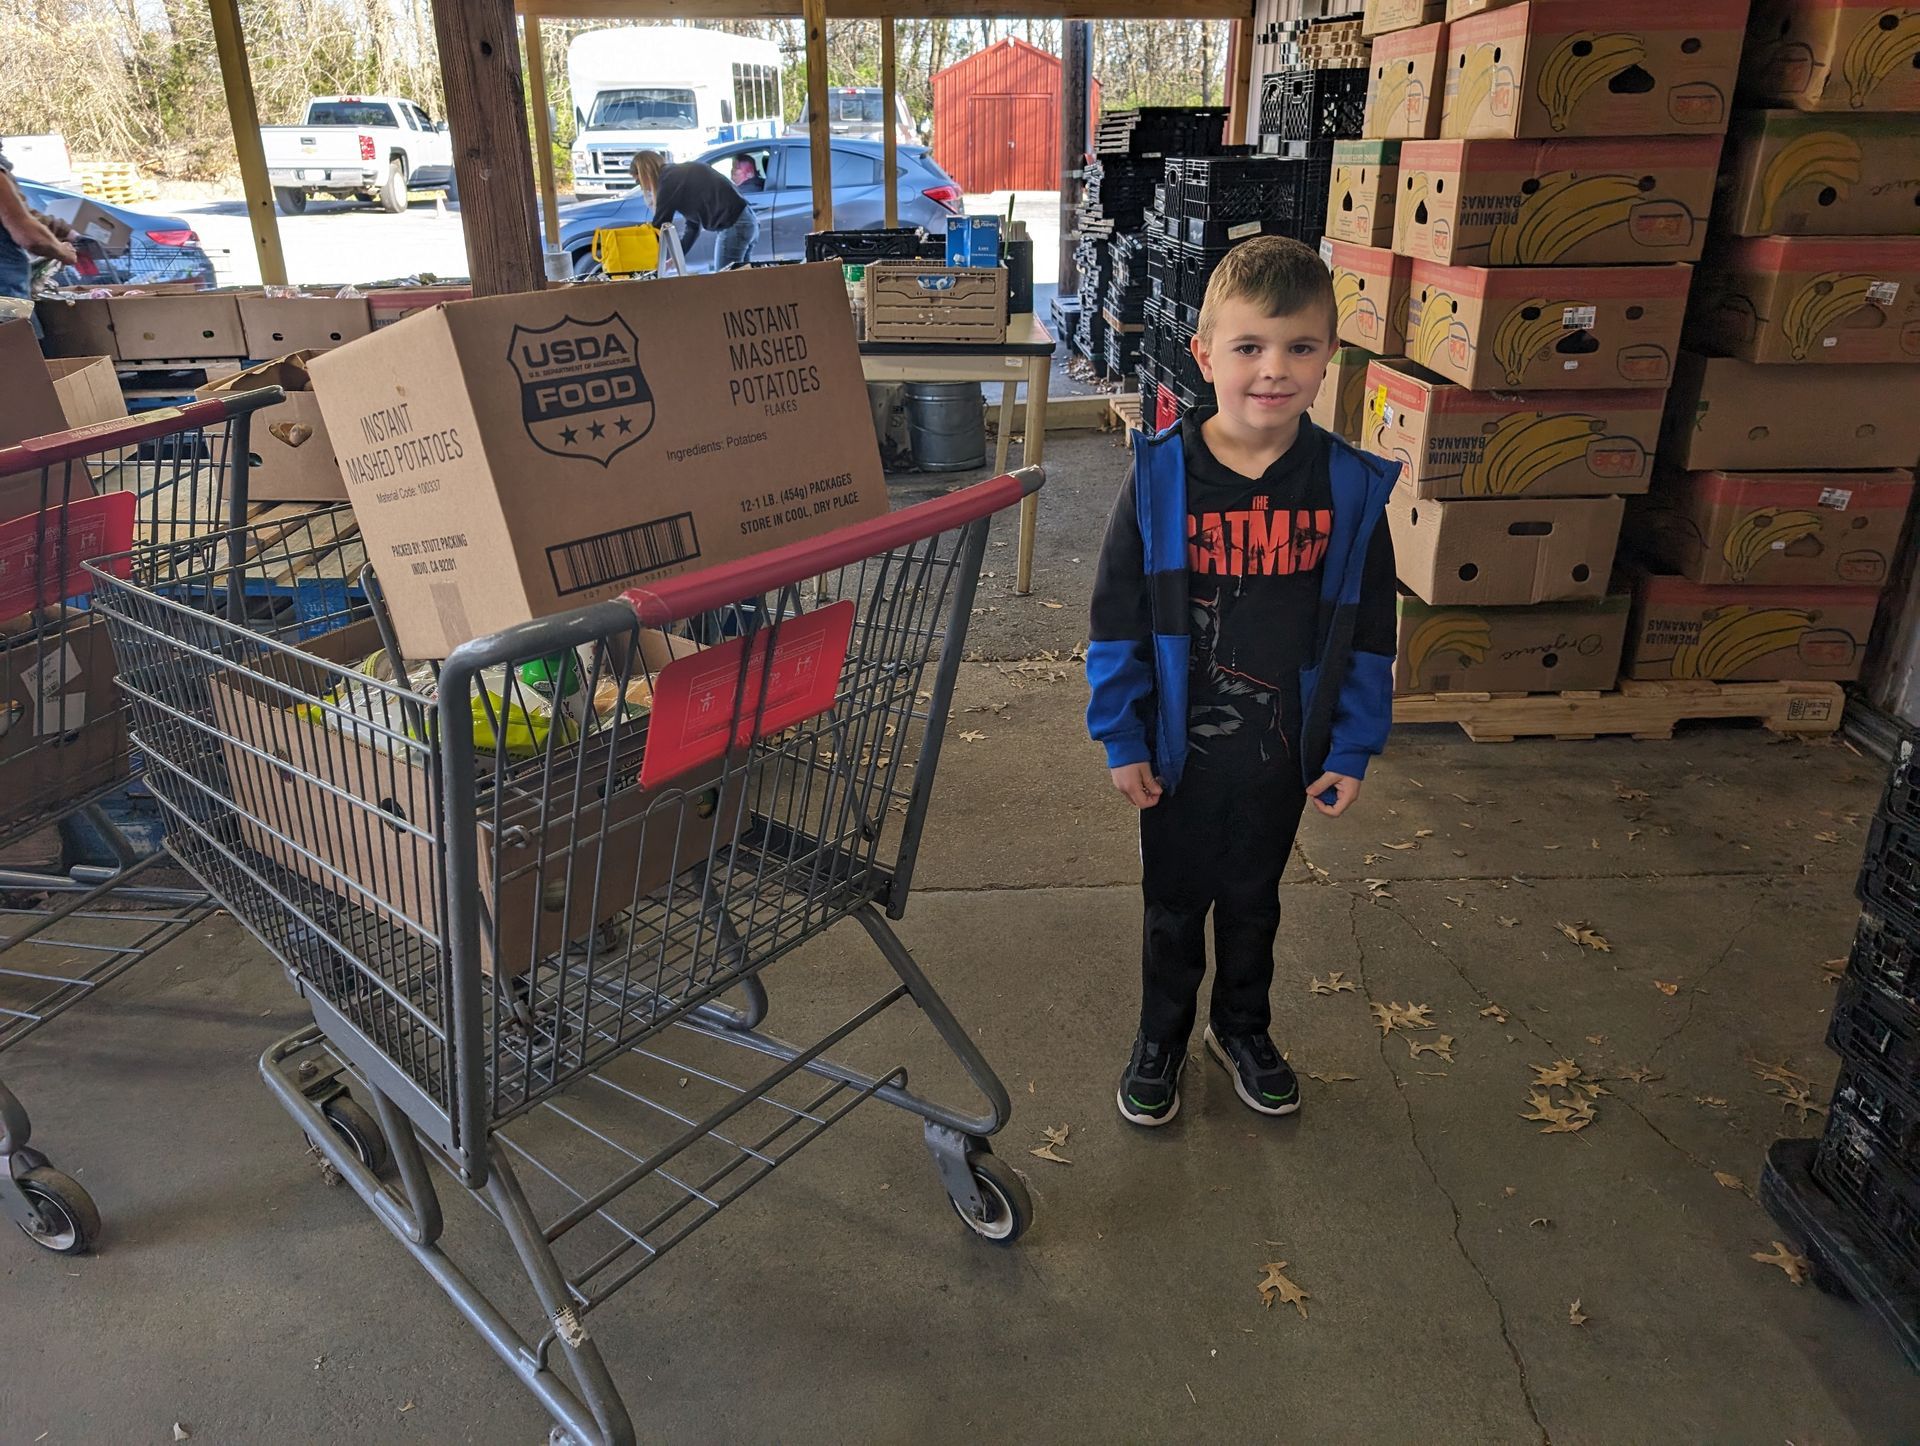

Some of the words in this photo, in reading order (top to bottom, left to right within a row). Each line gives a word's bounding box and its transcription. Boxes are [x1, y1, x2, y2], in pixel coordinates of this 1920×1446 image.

[1462, 195, 1521, 209] BANANAS
[1460, 212, 1518, 226] PREMIUM
[722, 302, 799, 339] INSTANT
[522, 333, 627, 368] USDA
[729, 334, 808, 371] MASHED
[542, 364, 583, 376] DEPARTMENT
[593, 357, 631, 369] AGRICULTURE
[535, 375, 637, 413] FOOD
[729, 365, 821, 406] POTATOES
[764, 399, 798, 417] FLAKES
[360, 403, 414, 445] INSTANT
[345, 448, 396, 485] MASHED
[394, 428, 464, 473] POTATOES
[666, 441, 724, 462] Ingredients:
[726, 431, 768, 448] Potatoes
[1430, 436, 1486, 449] BANANAS
[1428, 451, 1484, 464] PREMIUM
[376, 489, 400, 504] Material
[400, 487, 417, 500] Code:
[417, 479, 441, 495] 100337
[740, 498, 760, 513] 12-1
[762, 493, 778, 507] LB.
[780, 485, 808, 505] (454g)
[809, 473, 853, 495] PACKAGES
[1252, 495, 1270, 510] THE
[740, 516, 772, 535] STORE
[773, 512, 784, 527] IN
[785, 506, 812, 523] COOL,
[814, 500, 831, 514] DRY
[833, 491, 860, 509] PLACE
[391, 543, 413, 557] PACKED
[411, 541, 423, 555] BY:
[421, 538, 441, 554] STUTZ
[440, 533, 468, 550] PACKING
[411, 561, 431, 576] INDIO,
[429, 560, 440, 573] CA
